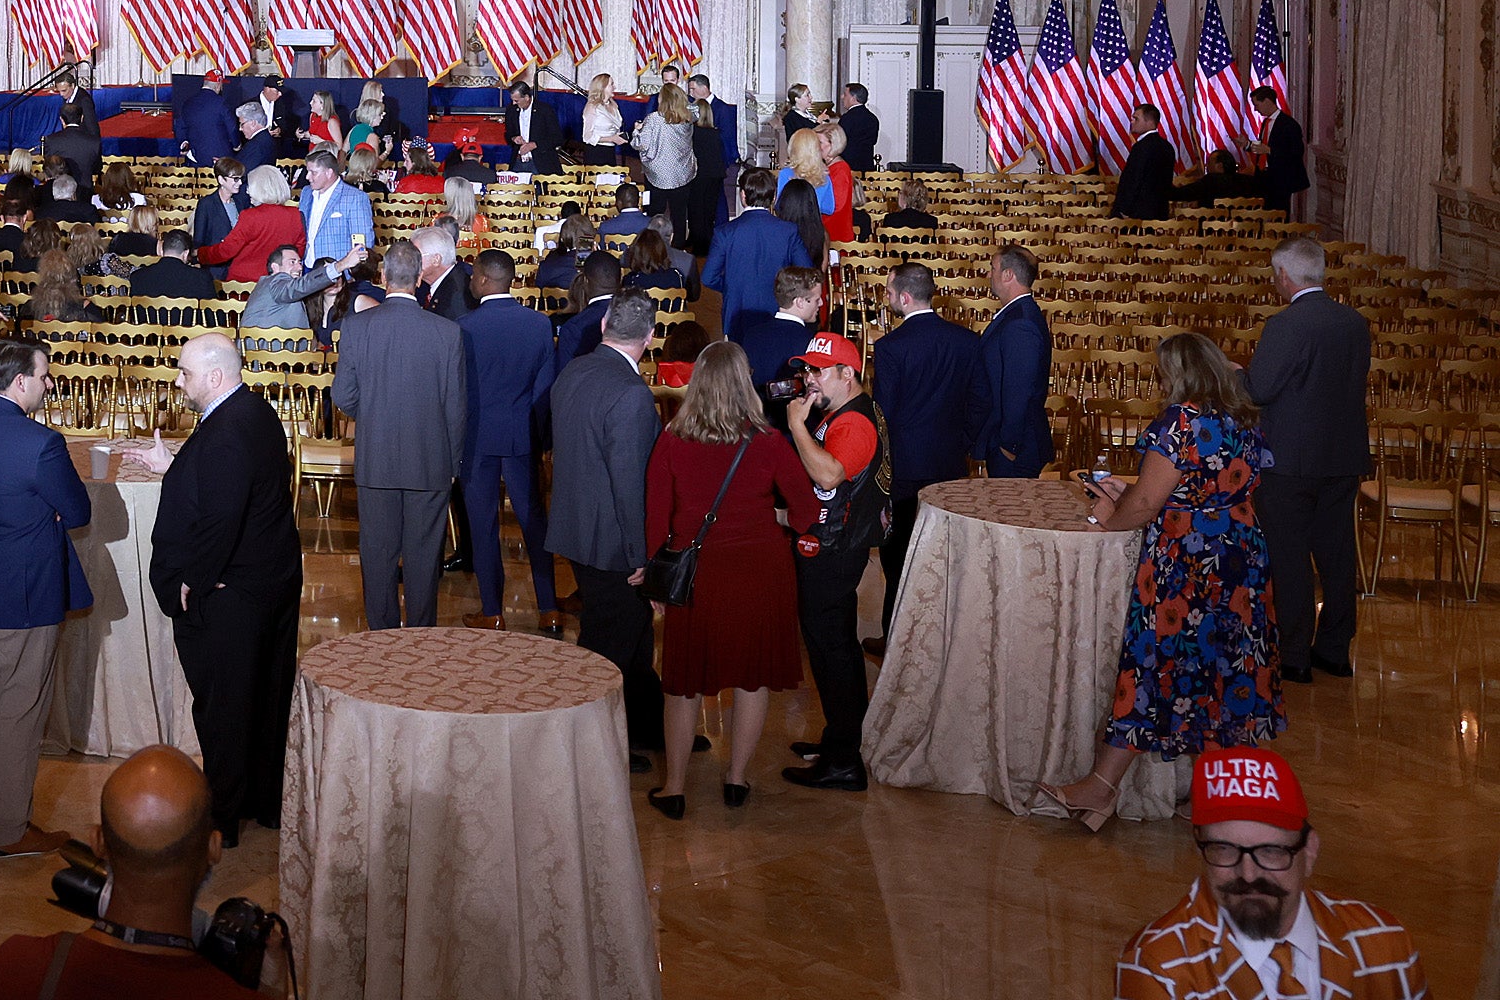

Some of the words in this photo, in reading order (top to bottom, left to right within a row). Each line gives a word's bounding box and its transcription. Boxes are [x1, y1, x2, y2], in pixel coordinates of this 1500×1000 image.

[497, 175, 518, 184] TRUMP
[1204, 758, 1279, 781] ULTRA
[1207, 778, 1281, 802] MAGA
